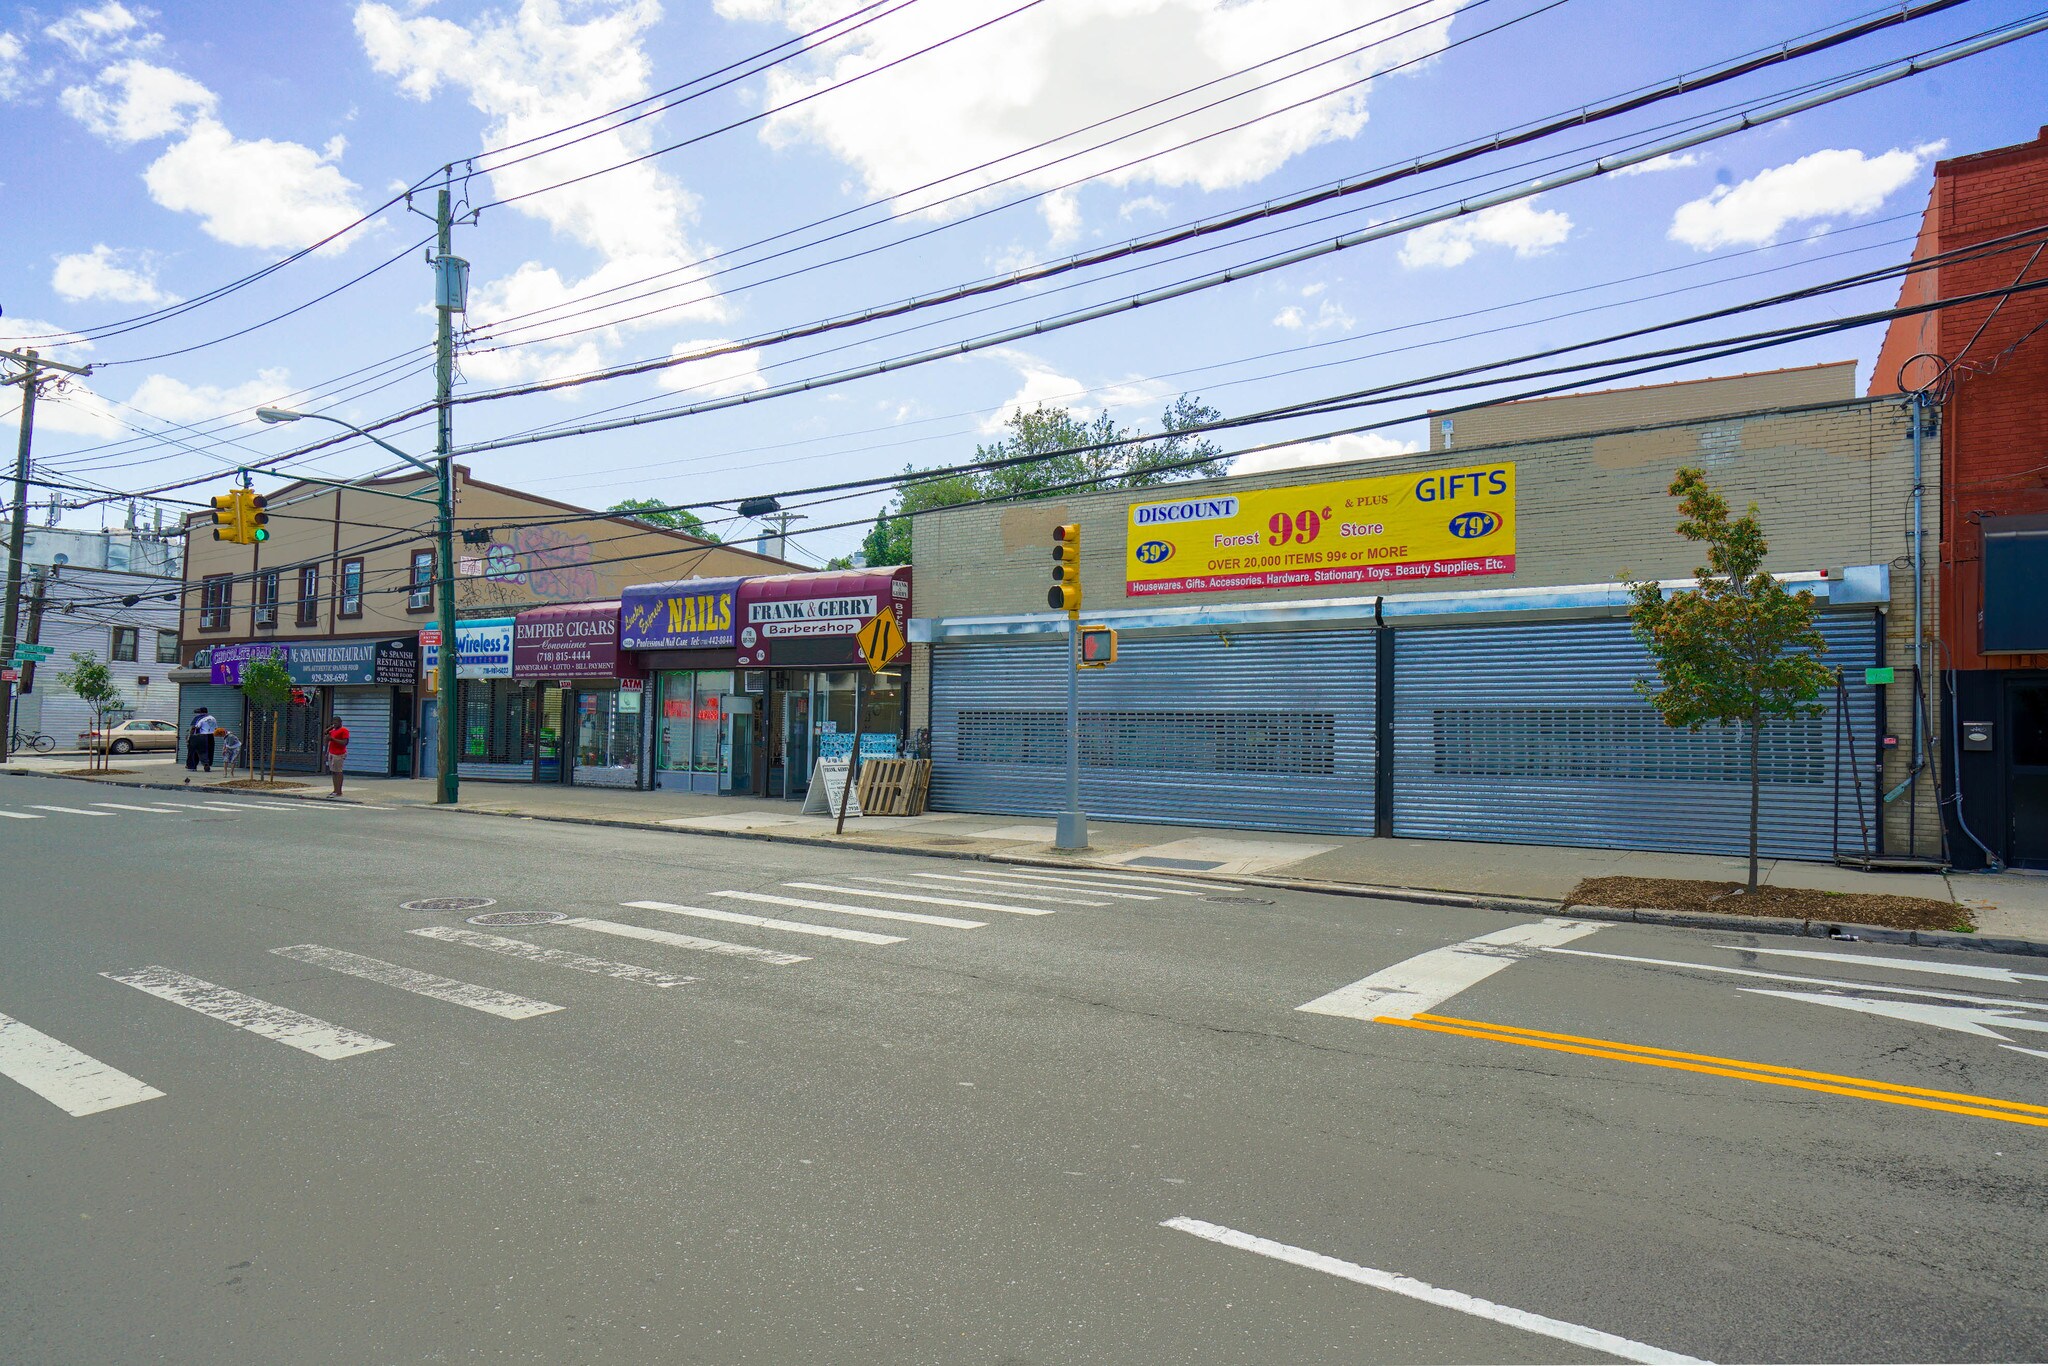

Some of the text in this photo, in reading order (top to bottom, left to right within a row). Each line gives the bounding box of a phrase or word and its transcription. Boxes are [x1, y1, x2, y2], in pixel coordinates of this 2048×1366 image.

[1415, 470, 1507, 502] GIFTS
[1345, 495, 1389, 508] & PLUS
[1138, 500, 1235, 523] DISCOUNT
[1213, 506, 1384, 548] Forest 99¢ Store
[1207, 546, 1408, 570] OVER 20,000 ITEMS 99¢ or MORE
[1395, 564, 1431, 577] Beauty
[1485, 559, 1507, 570] Etc.
[624, 604, 645, 632] Lucky
[638, 599, 664, 635] Express
[667, 593, 732, 633] NAILS
[752, 598, 873, 621] FRANK & GERRY
[516, 620, 615, 639] EMPIRE CIGARS
[769, 623, 855, 634] Barbershop
[456, 633, 510, 653] Wireless 2
[541, 640, 587, 650] Convenience
[636, 636, 665, 648] Professional
[665, 636, 676, 647] Nail
[214, 647, 250, 665] CHOCOLATE
[300, 647, 326, 662] SPANISH
[327, 645, 373, 662] RESTAURANT
[376, 657, 416, 667] RESTAURANT
[389, 650, 414, 659] SPANISH
[537, 650, 591, 662] (718) 815-4444
[311, 673, 348, 683] 929-288-6592
[621, 679, 642, 689] ATM
